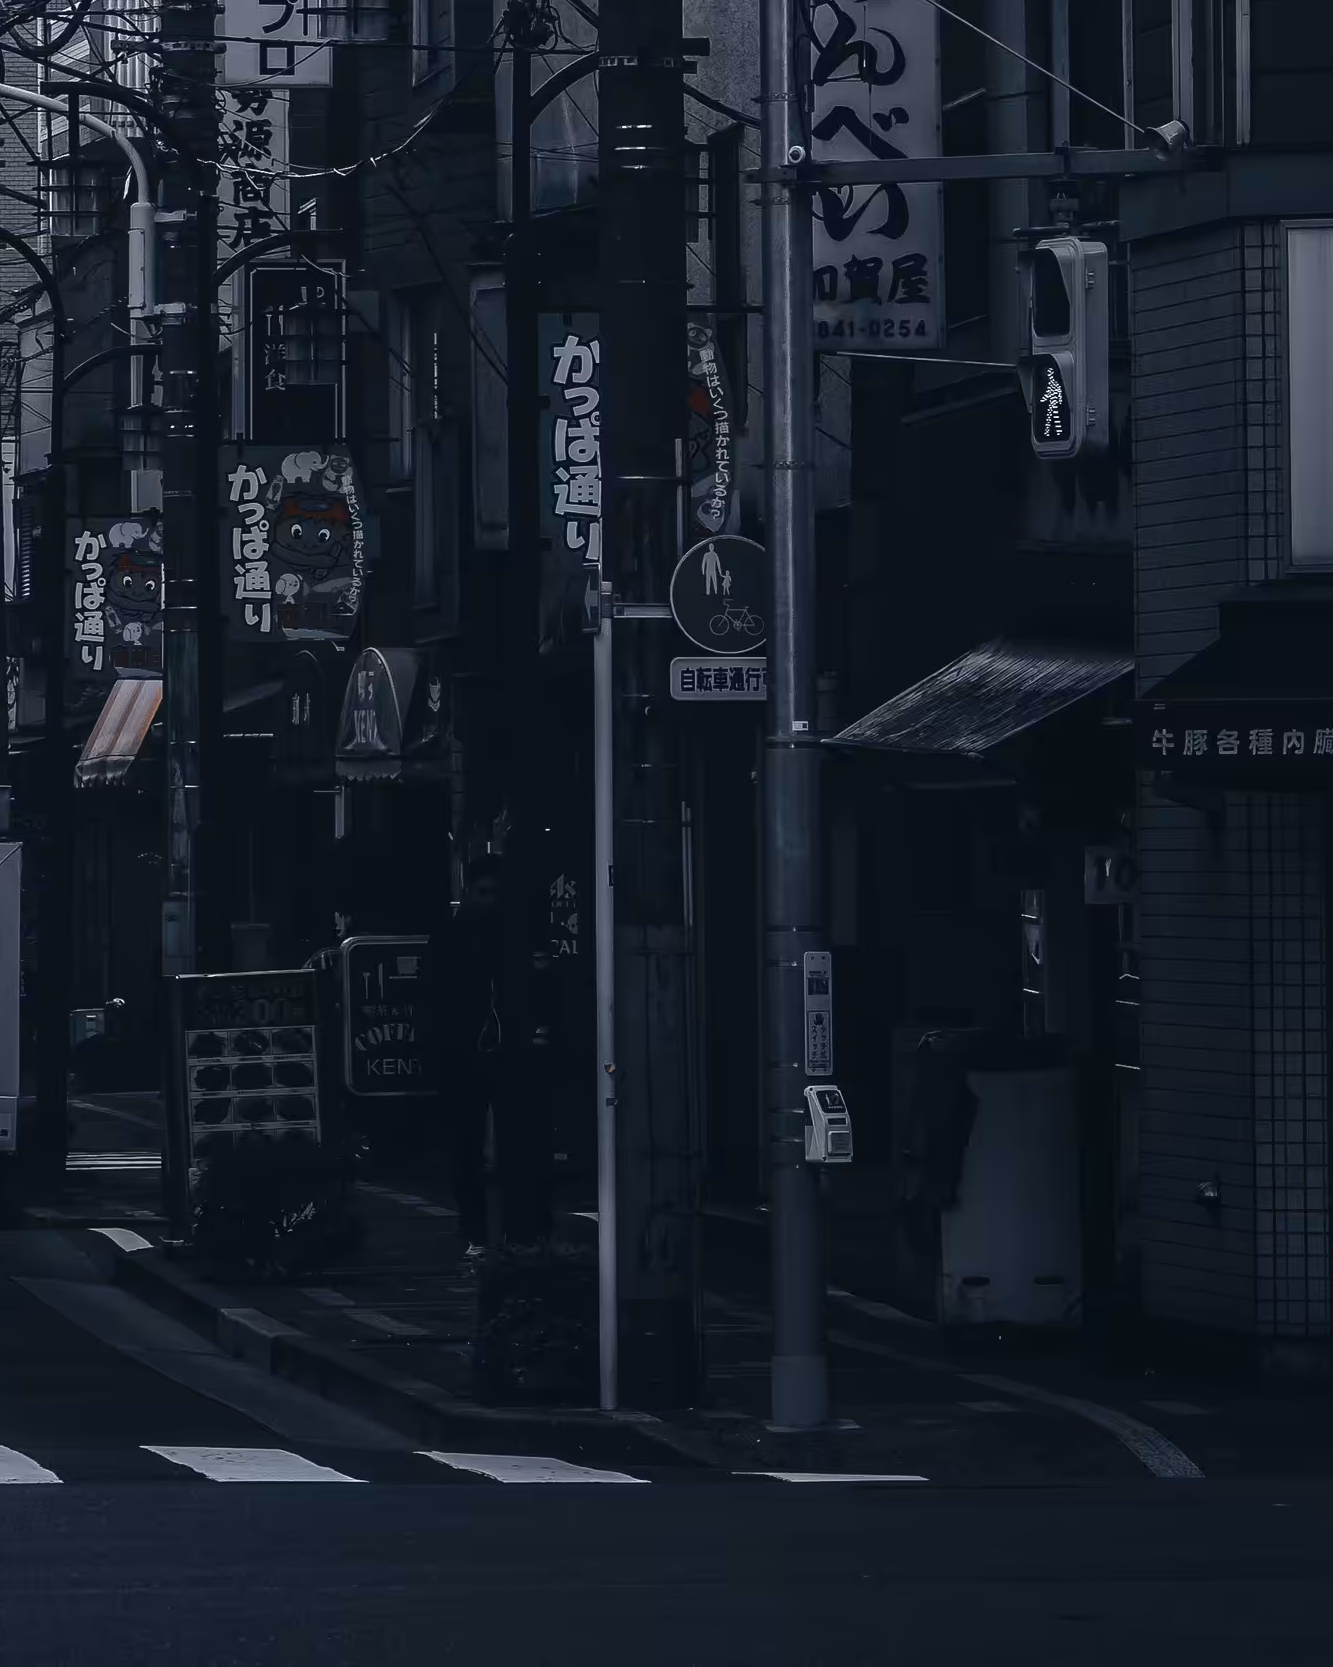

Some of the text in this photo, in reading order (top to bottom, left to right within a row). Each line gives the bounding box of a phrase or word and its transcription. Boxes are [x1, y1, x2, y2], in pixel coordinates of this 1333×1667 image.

[553, 335, 600, 560] かっぱ通り
[75, 530, 106, 671] かっぱ通り
[227, 465, 272, 633] かっぱ通り
[681, 667, 767, 692] 自転車通行
